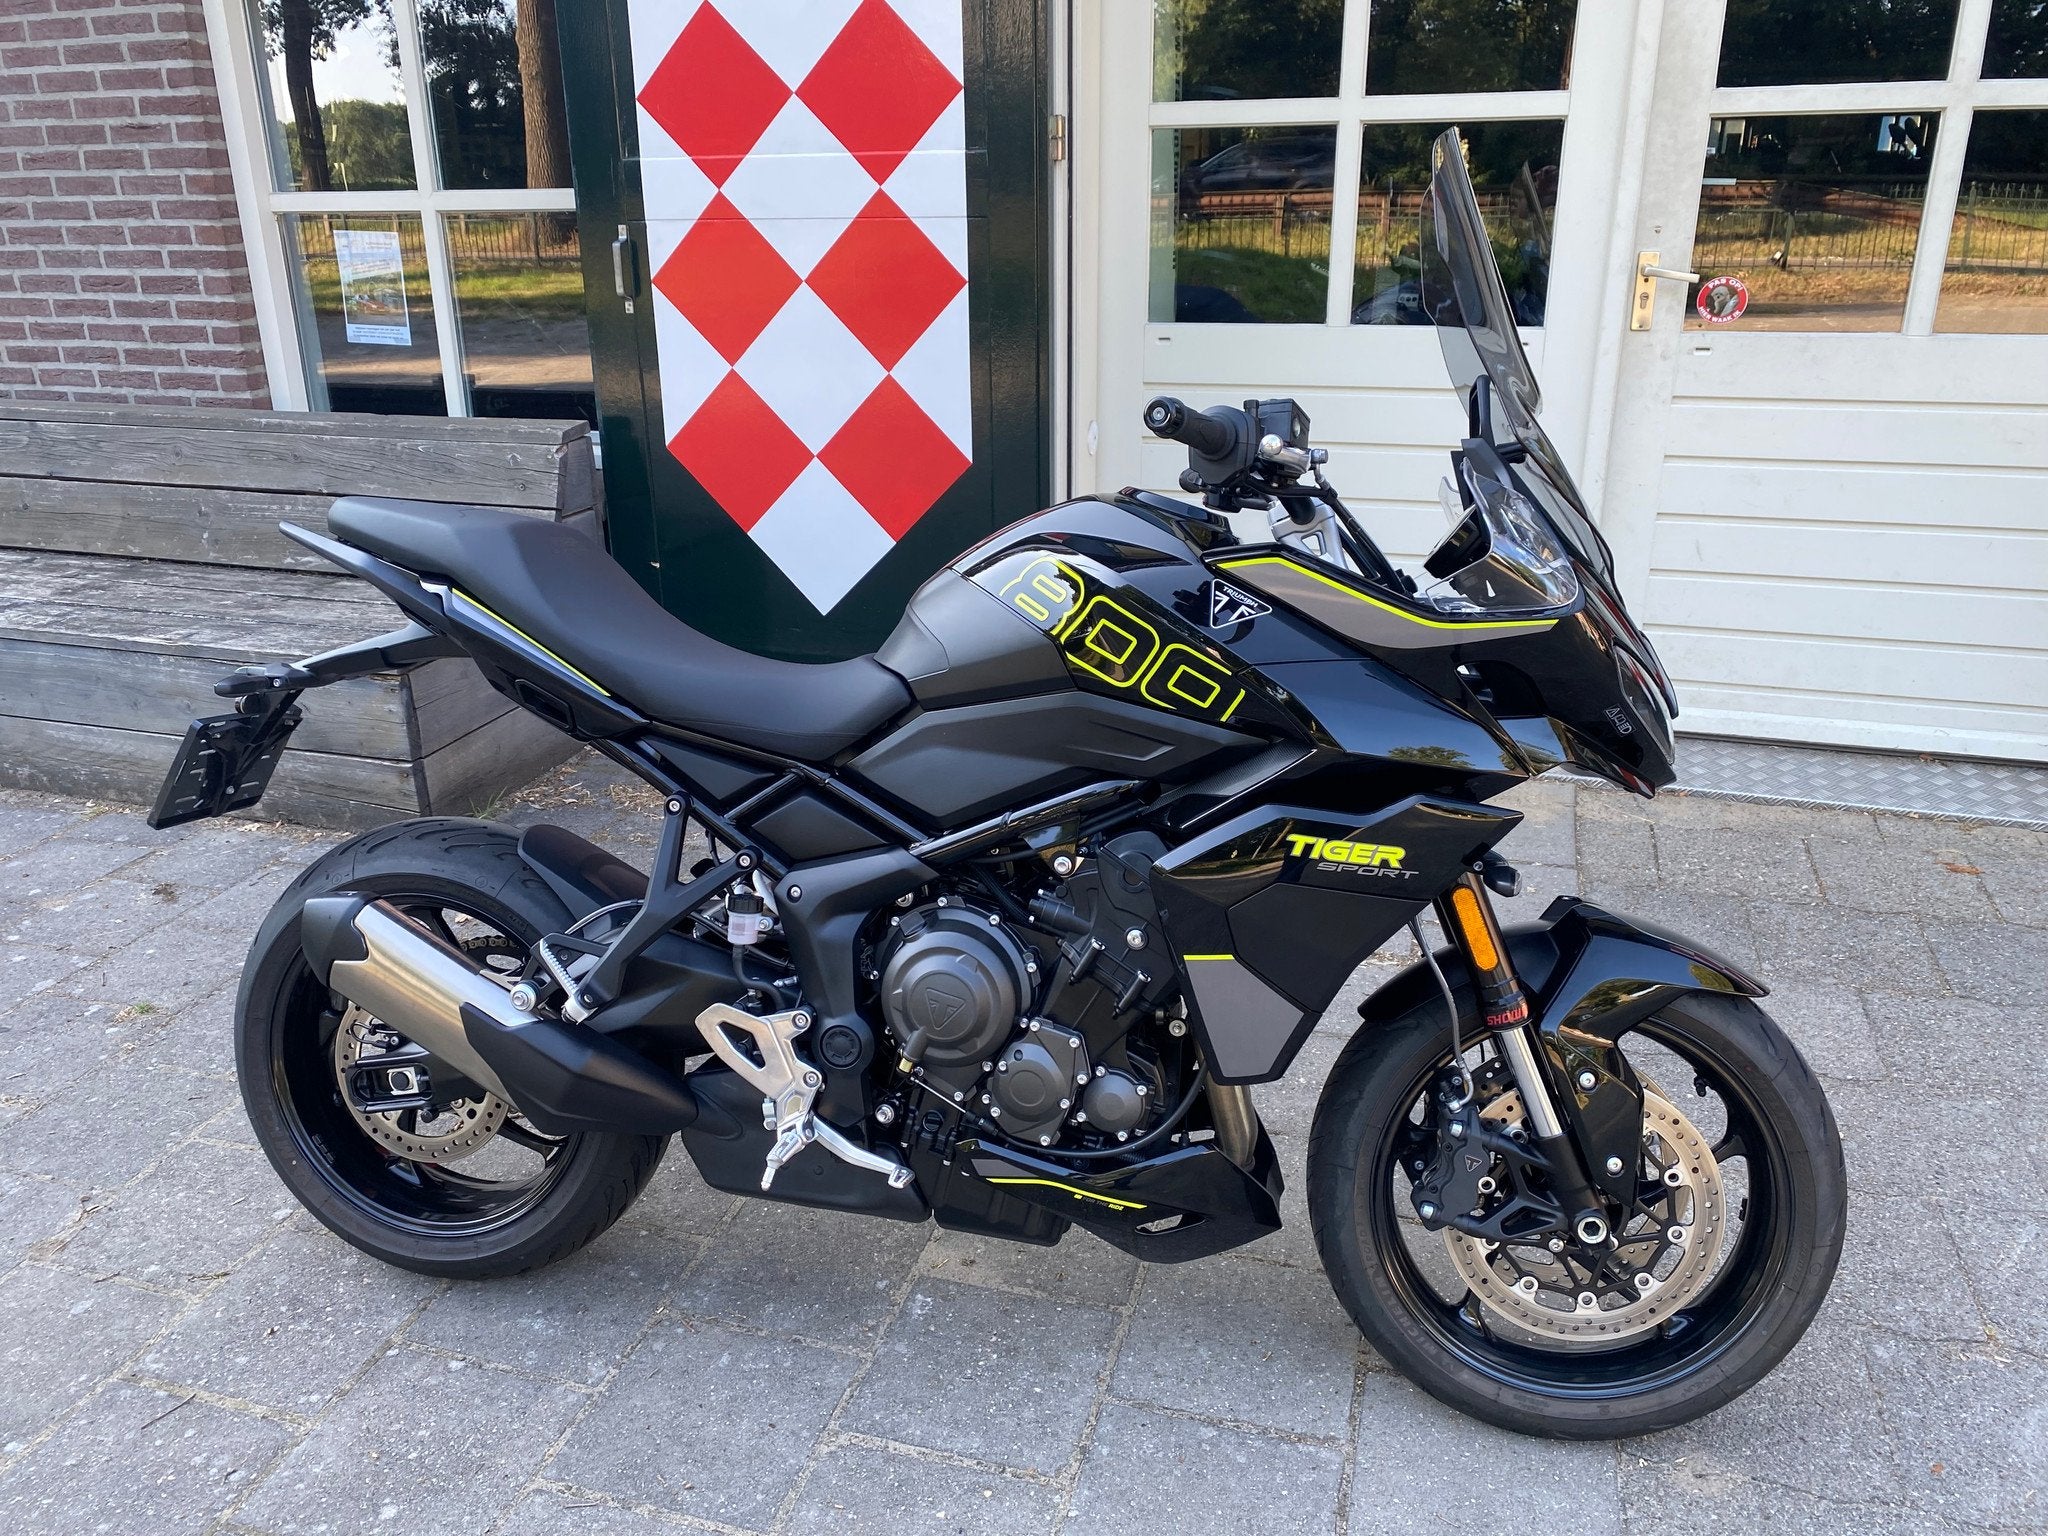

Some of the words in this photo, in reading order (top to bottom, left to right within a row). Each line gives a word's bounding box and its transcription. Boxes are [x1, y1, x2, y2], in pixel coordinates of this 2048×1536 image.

[1708, 278, 1727, 289] PAS
[1223, 585, 1259, 608] TRIUMPH
[1000, 555, 1246, 723] 800
[1286, 833, 1406, 869] TIGER
[1316, 861, 1420, 879] SPORT
